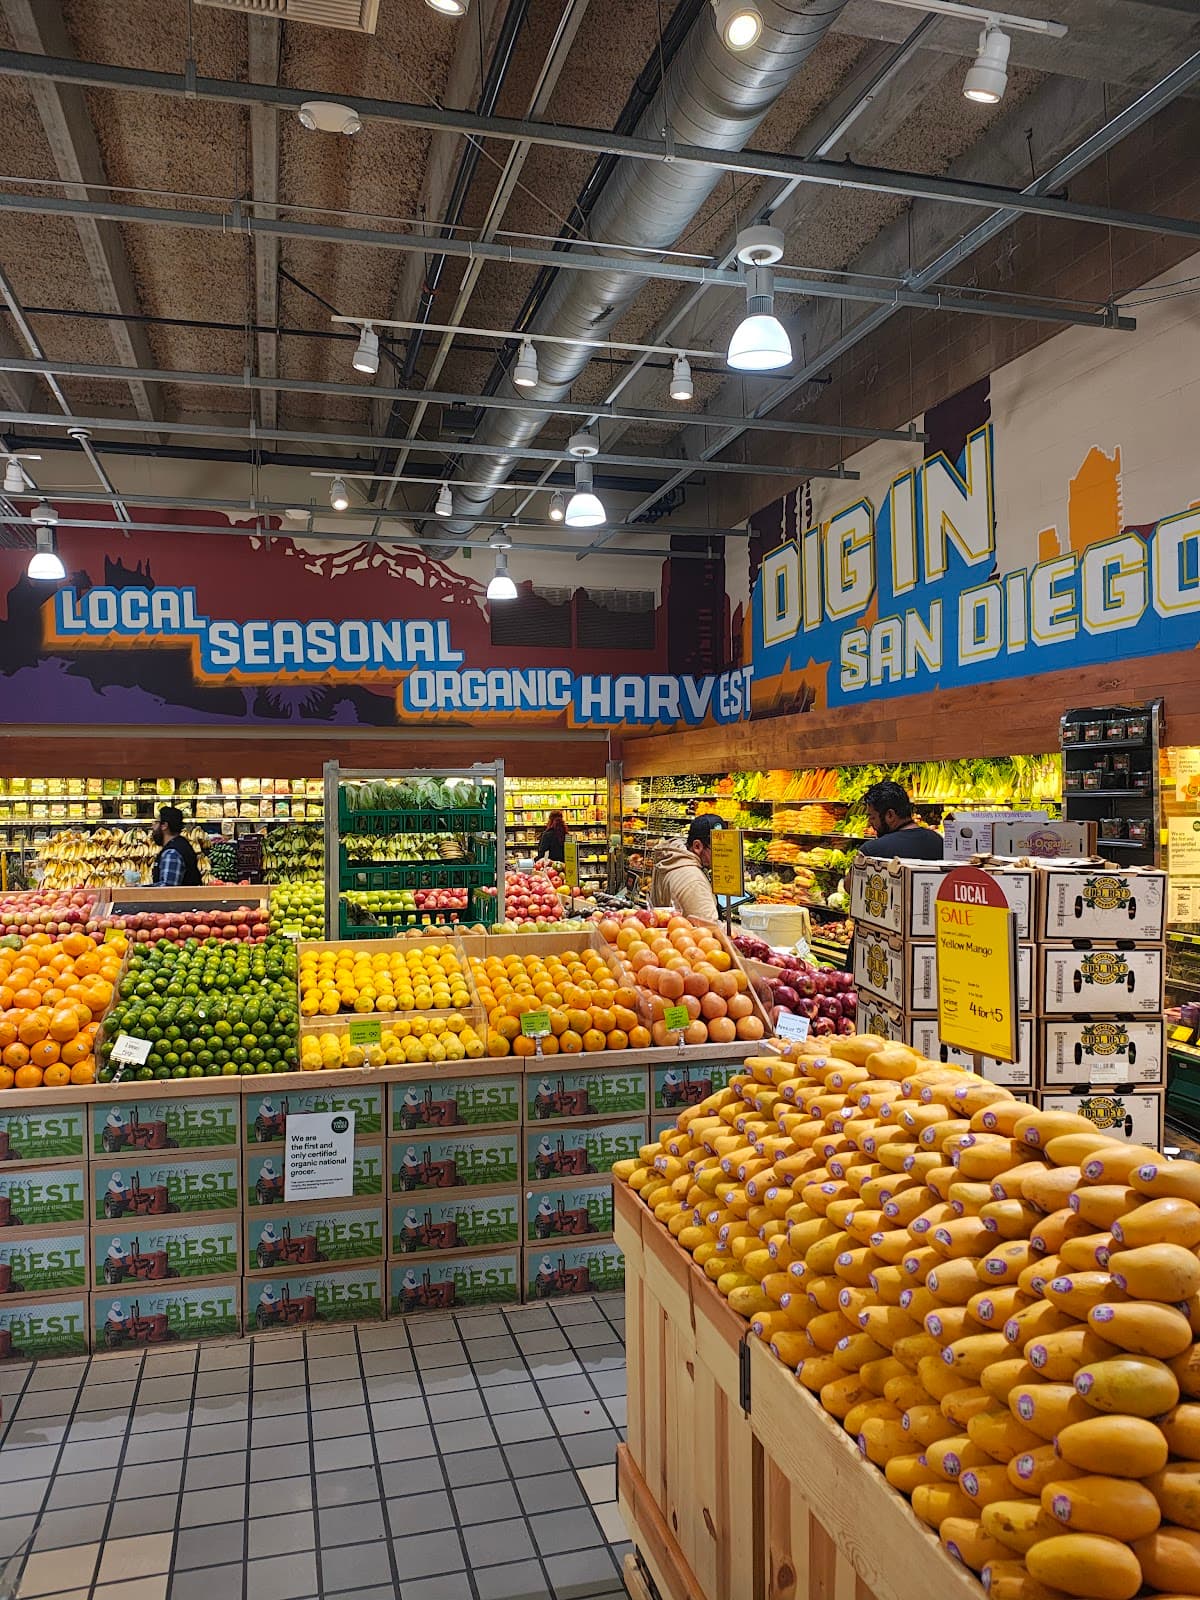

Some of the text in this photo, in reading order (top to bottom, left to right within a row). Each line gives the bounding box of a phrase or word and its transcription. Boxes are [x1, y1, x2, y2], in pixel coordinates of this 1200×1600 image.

[762, 423, 995, 648] DIG IN
[61, 590, 206, 629] LOCAL
[840, 508, 1200, 692] SAN DIEGO
[209, 620, 463, 665] SEASONAL
[409, 665, 755, 718] ORGANIC HARVEST
[954, 883, 989, 904] LOCAL
[941, 905, 977, 926] SALE
[940, 938, 993, 957] Yellow Mango
[969, 1002, 977, 1016] 4
[586, 1077, 642, 1099] BEST
[711, 1069, 737, 1089] BE
[455, 1087, 515, 1109] BEST
[7, 1118, 78, 1142] BEST
[165, 1108, 232, 1132] BEST
[291, 1150, 337, 1160] only certified
[304, 1142, 318, 1150] first
[319, 1141, 333, 1149] and
[585, 1136, 642, 1158] BEST
[290, 1157, 347, 1169] organic national
[353, 1158, 378, 1180] ST
[454, 1147, 514, 1169] BEST
[166, 1172, 233, 1196] BEST
[290, 1169, 317, 1177] grocer.
[9, 1183, 79, 1208] BEST
[455, 1207, 514, 1231] BEST
[587, 1197, 612, 1219] BE
[316, 1221, 379, 1245] BEST
[165, 1236, 233, 1262] BEST
[9, 1249, 80, 1276] BEST
[588, 1254, 625, 1276] BES
[453, 1268, 513, 1292] BEST
[314, 1282, 377, 1306] BEST
[165, 1299, 232, 1325] BEST
[9, 1315, 79, 1341] BEST
